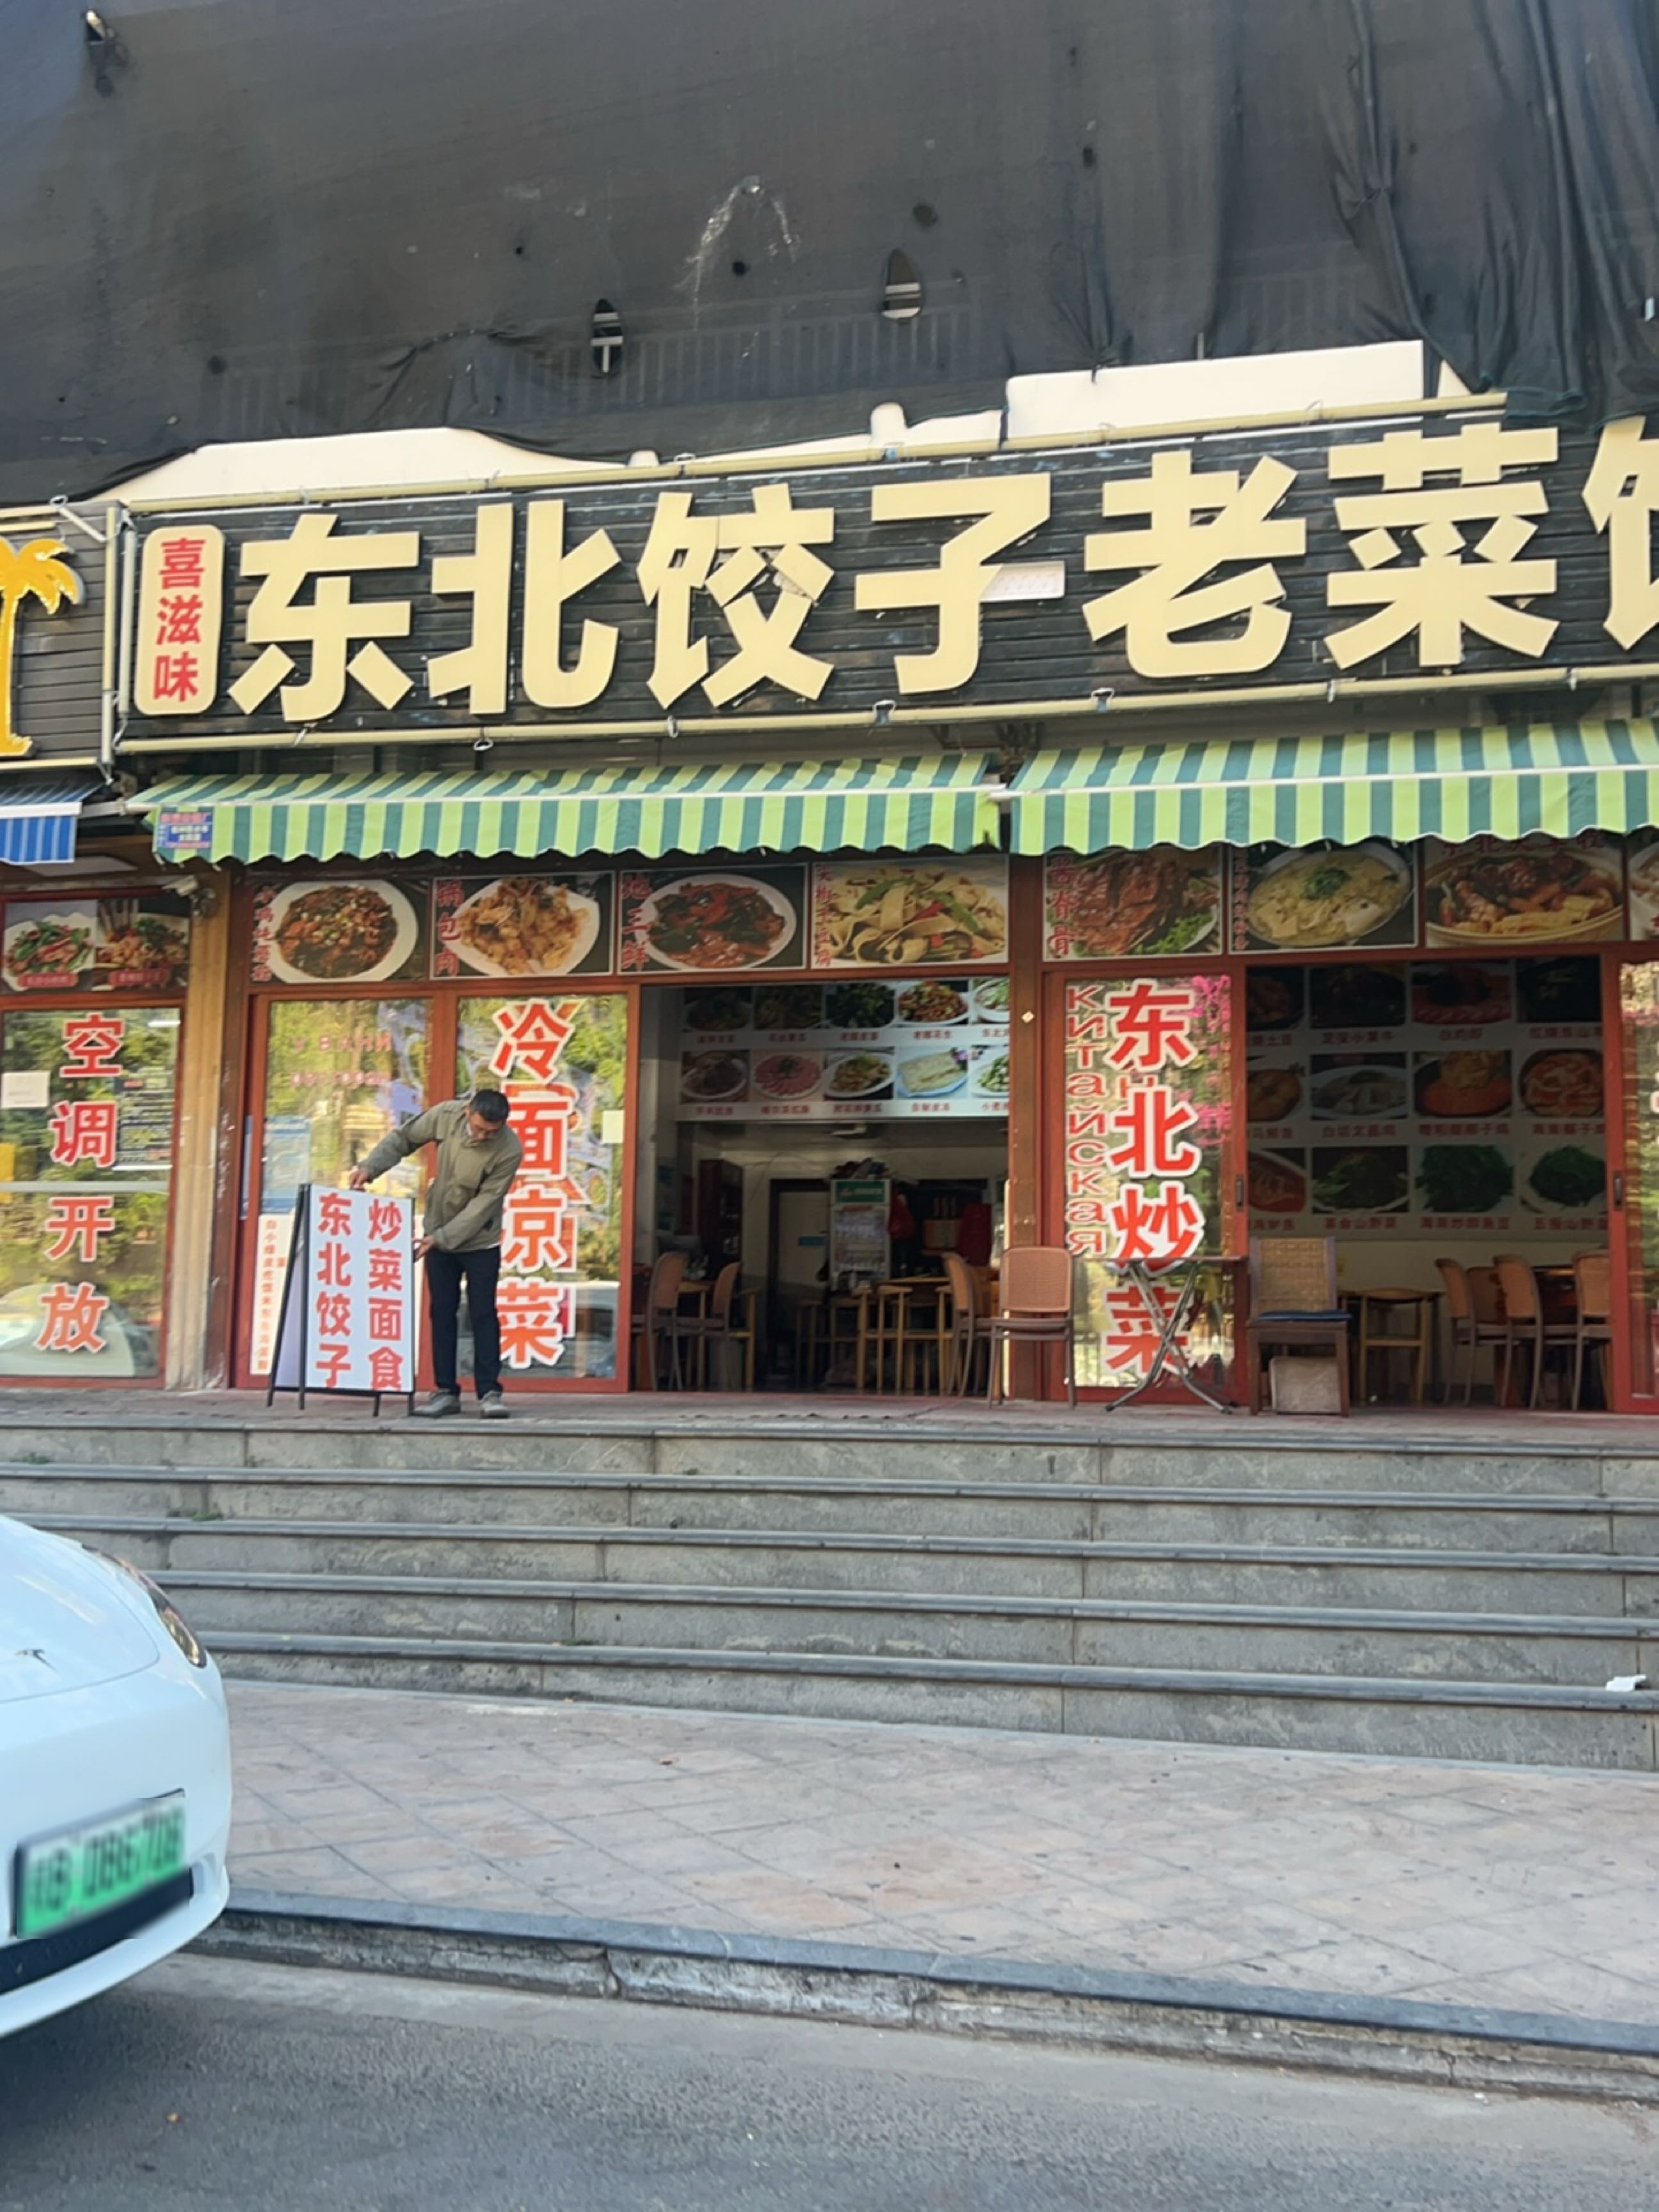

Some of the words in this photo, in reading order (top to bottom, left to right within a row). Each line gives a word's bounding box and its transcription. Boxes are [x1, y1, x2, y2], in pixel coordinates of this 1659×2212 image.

[153, 536, 206, 703] 喜滋味
[435, 879, 465, 977] 锅包肉
[37, 1013, 125, 1353] 空调开放
[1107, 982, 1203, 1374] 东北炒菜
[316, 1192, 353, 1388] 东北饺子
[368, 1198, 405, 1391] 炒菜面食
